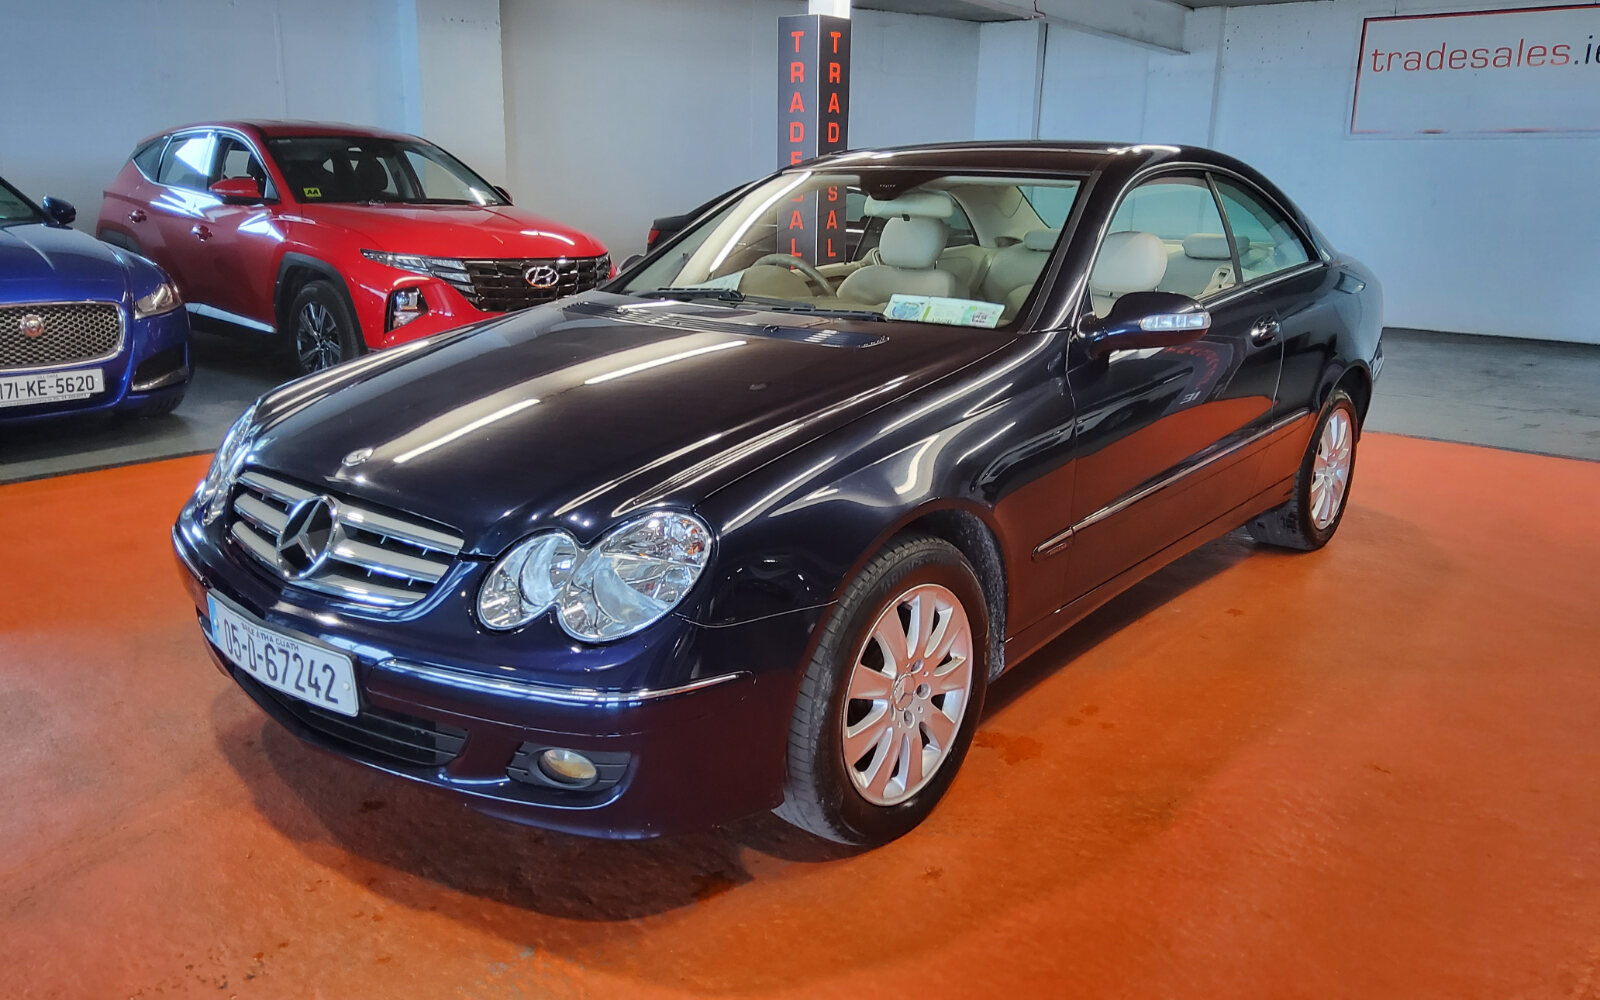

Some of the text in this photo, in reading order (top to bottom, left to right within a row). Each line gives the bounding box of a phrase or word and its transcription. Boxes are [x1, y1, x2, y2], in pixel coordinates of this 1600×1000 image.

[1372, 35, 1600, 72] tradesales.i
[0, 375, 95, 400] 171-KE-5620
[223, 618, 339, 704] 05-D-67242
